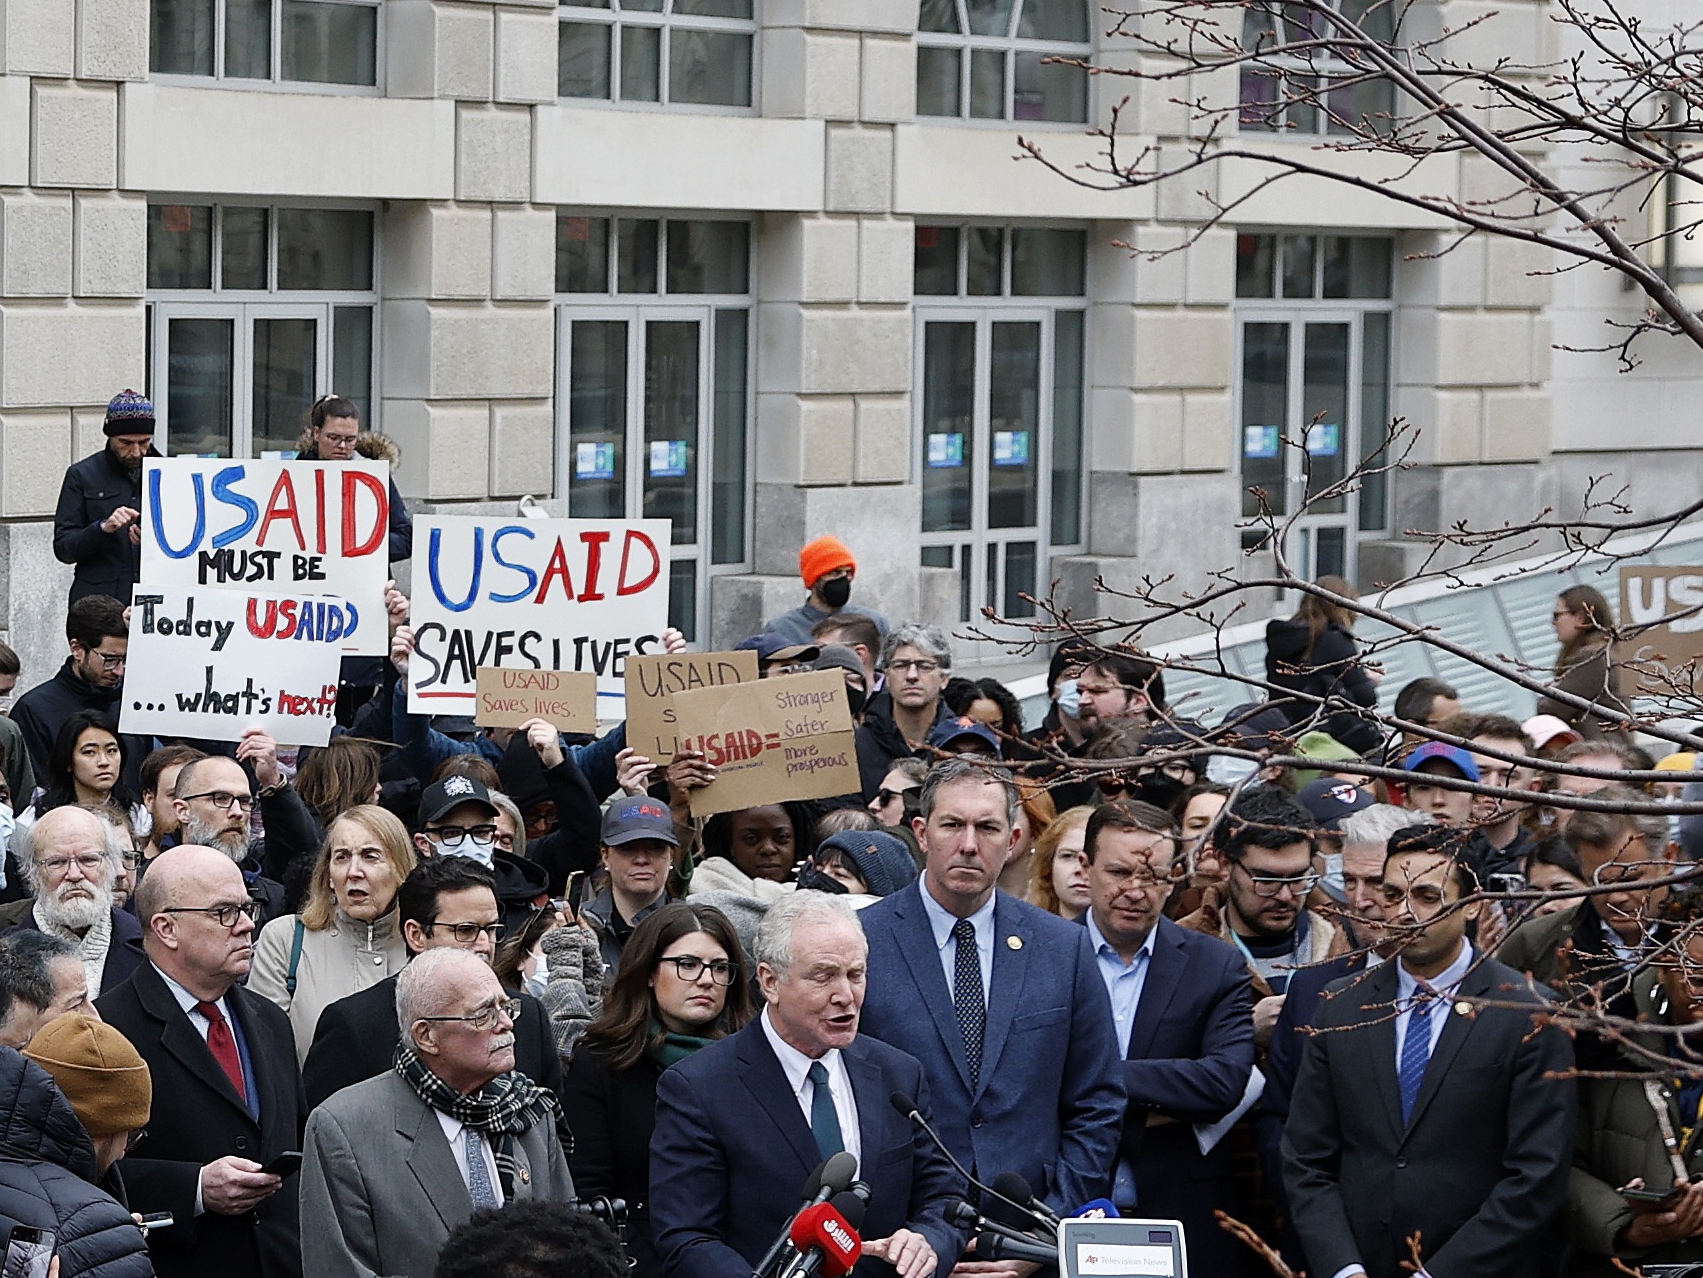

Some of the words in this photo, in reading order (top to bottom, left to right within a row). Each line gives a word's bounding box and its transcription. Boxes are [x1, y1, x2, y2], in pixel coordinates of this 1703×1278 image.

[148, 464, 388, 558] USAID
[198, 549, 281, 584] MUST
[293, 554, 327, 581] BE
[429, 525, 661, 612] USAID
[134, 594, 235, 651] Today
[246, 597, 344, 643] USAID
[414, 622, 542, 689] SAVES
[176, 665, 272, 716] what's
[503, 671, 559, 691] USAID
[639, 661, 741, 697] USAID
[482, 693, 529, 713] Saves
[776, 688, 838, 714] Stronger
[785, 716, 829, 737] Safer
[786, 752, 849, 777] prosperous
[1085, 1255, 1098, 1265] AP
[1100, 1256, 1141, 1265] Television
[1144, 1258, 1168, 1266] News
